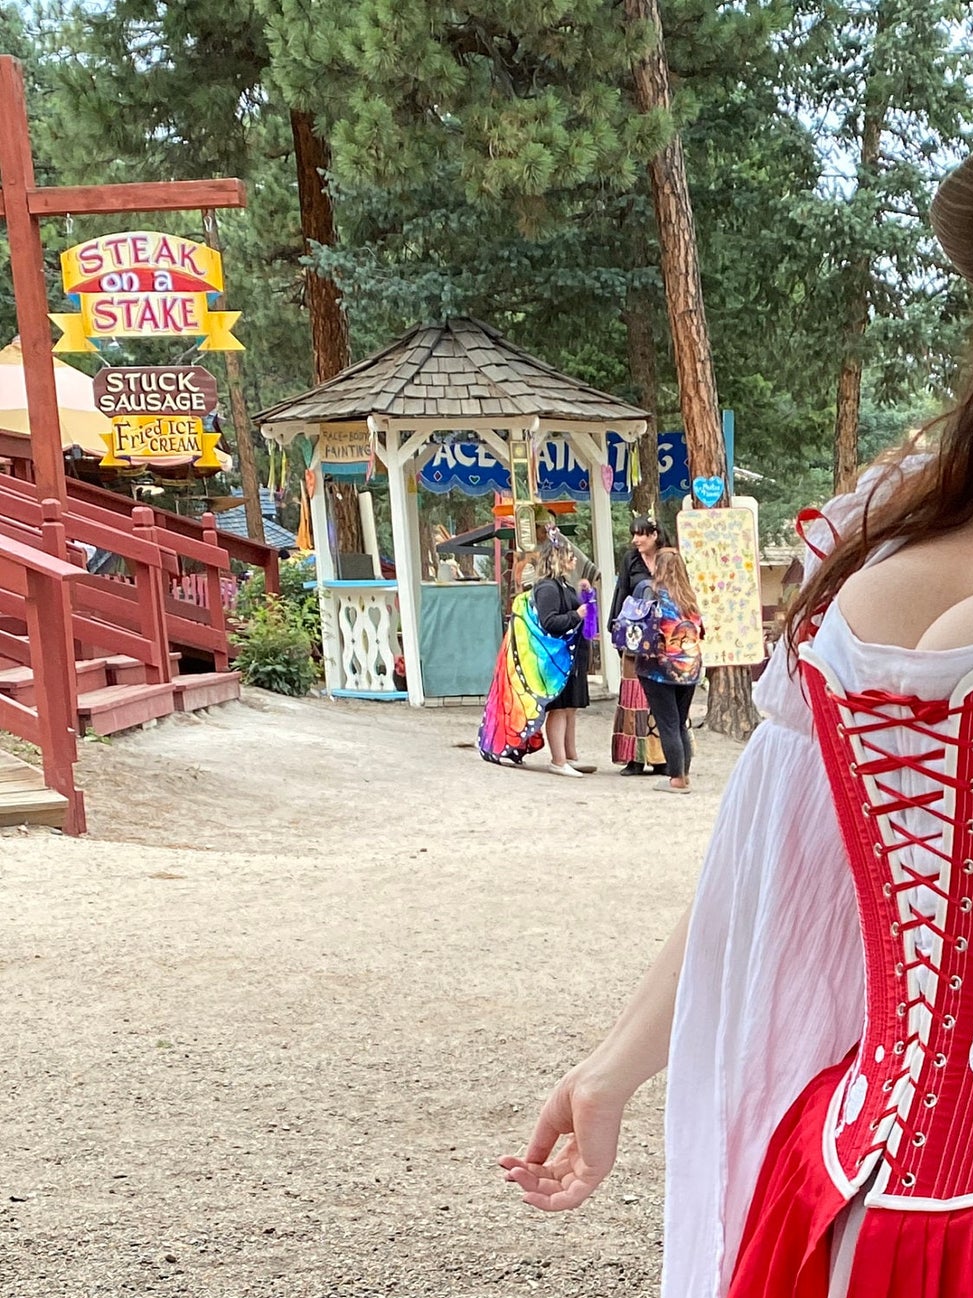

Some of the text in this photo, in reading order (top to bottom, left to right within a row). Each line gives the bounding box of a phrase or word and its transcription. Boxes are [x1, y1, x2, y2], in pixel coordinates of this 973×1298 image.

[79, 236, 205, 274] STEAK
[100, 270, 173, 292] on a
[94, 295, 198, 332] STAKE
[106, 372, 200, 392] STUCK
[100, 393, 206, 412] SAUSAGE
[114, 418, 198, 451] Fried ICE
[150, 437, 202, 452] CREAM
